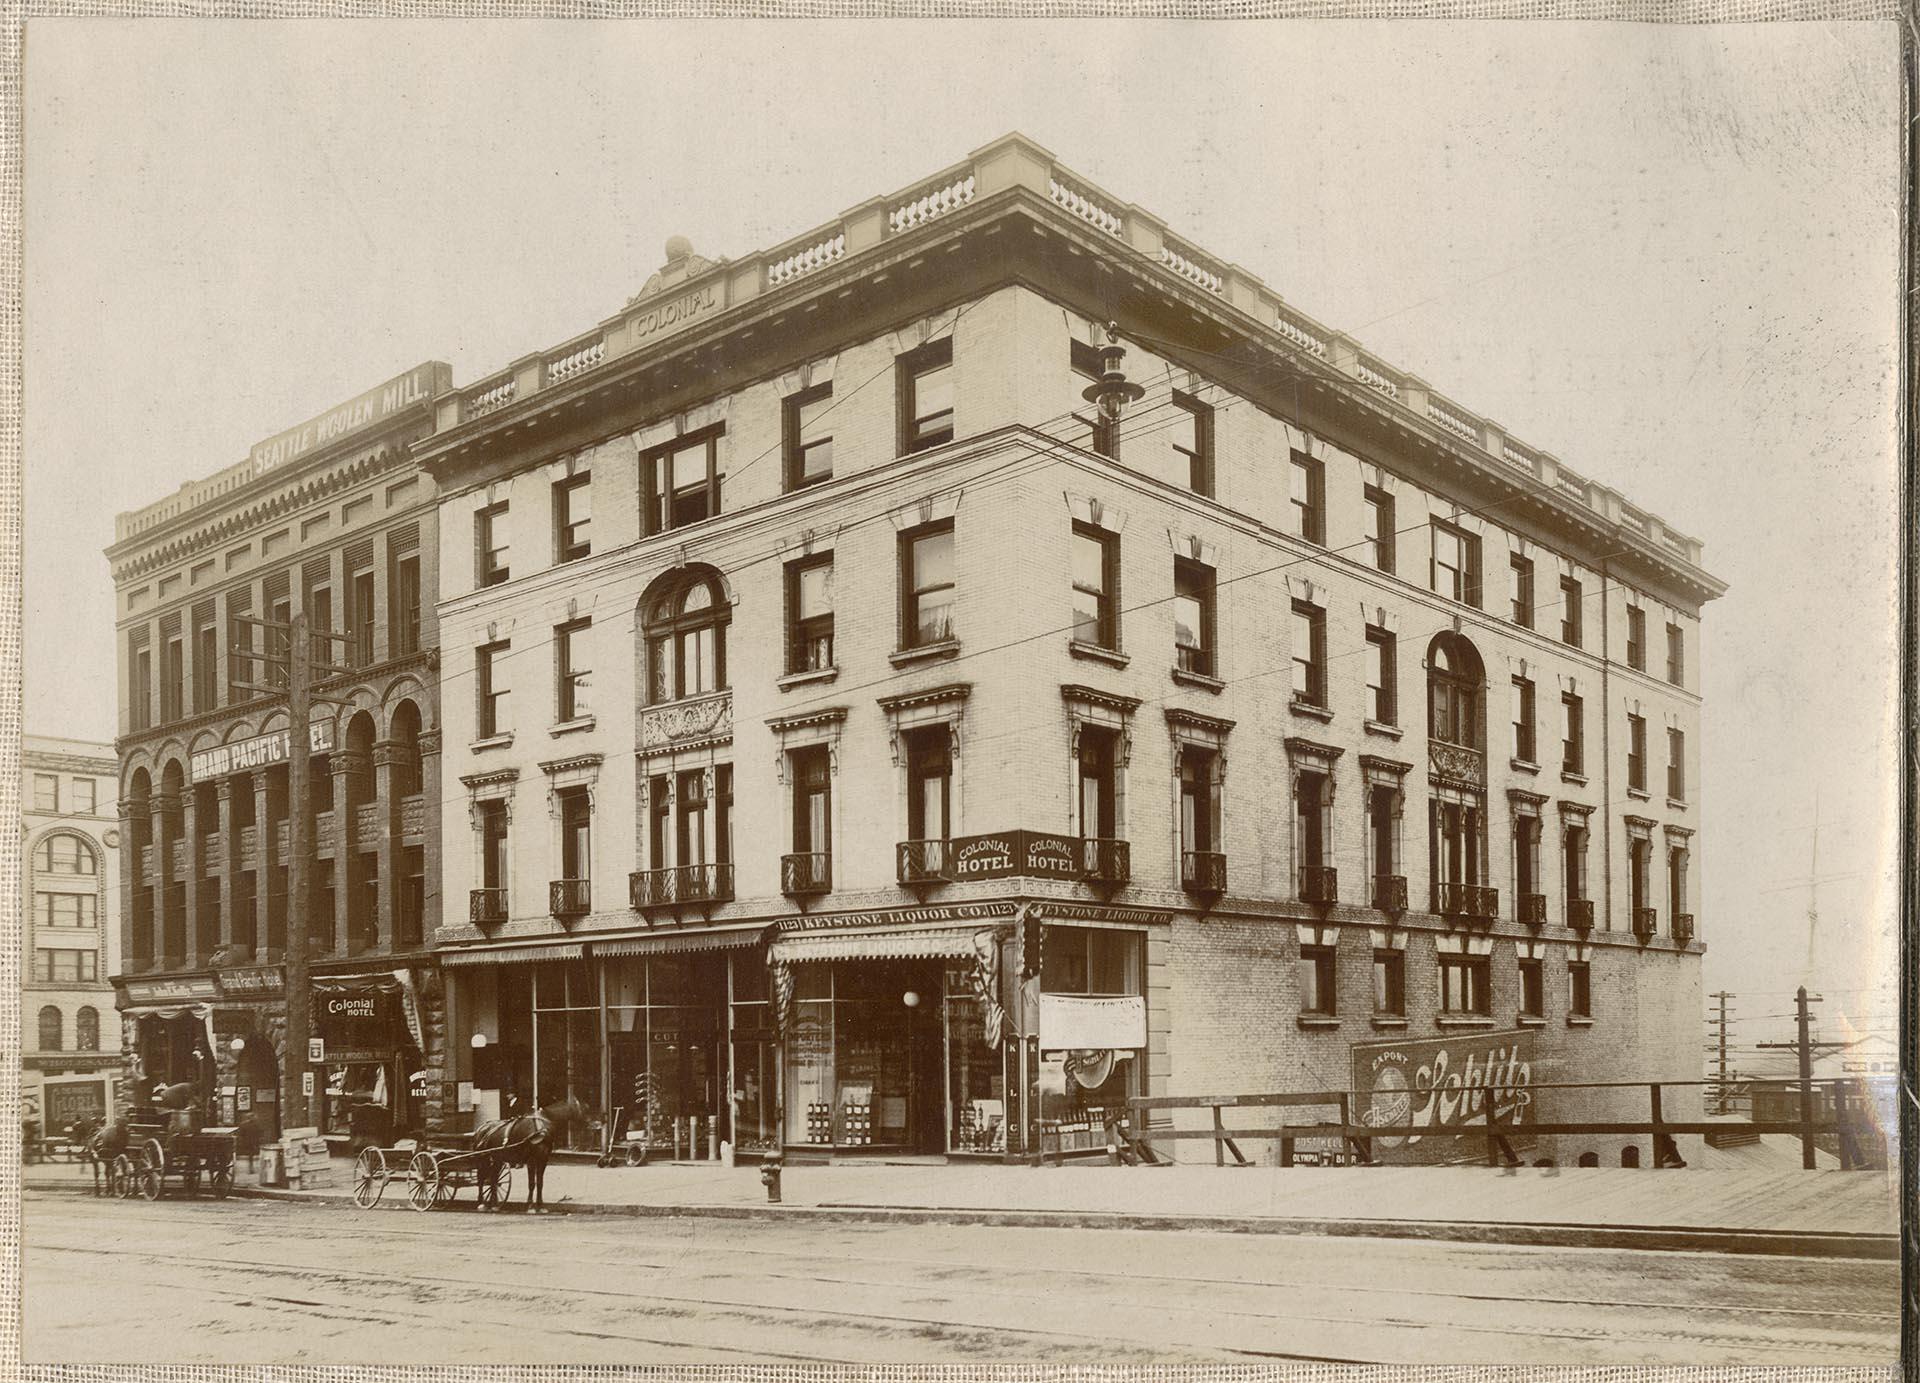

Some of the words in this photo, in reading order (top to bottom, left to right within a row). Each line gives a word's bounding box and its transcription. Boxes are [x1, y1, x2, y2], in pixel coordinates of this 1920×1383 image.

[638, 288, 715, 337] COLONIAL
[255, 428, 310, 474] SEATTLE
[316, 399, 373, 445] WOOLEN
[192, 748, 230, 783] GRAND
[232, 735, 281, 770] PACIFIC
[959, 839, 1012, 860] COLONIAL
[1029, 839, 1073, 859] COLONIAL
[957, 856, 1014, 873] HOTEL
[1027, 855, 1077, 873] HOTEL
[804, 914, 882, 929] KEYSTONE
[889, 908, 951, 923] LIQUOR
[957, 905, 987, 918] CO.
[990, 904, 1014, 916] 1123
[1041, 903, 1101, 919] EYSTONE
[1105, 909, 1150, 922] LIQUOR
[328, 999, 374, 1013] Colonial
[1372, 1051, 1408, 1071] EXPORT
[1408, 1045, 1531, 1144] Schlitz
[1292, 1153, 1319, 1163] OLYMPIA
